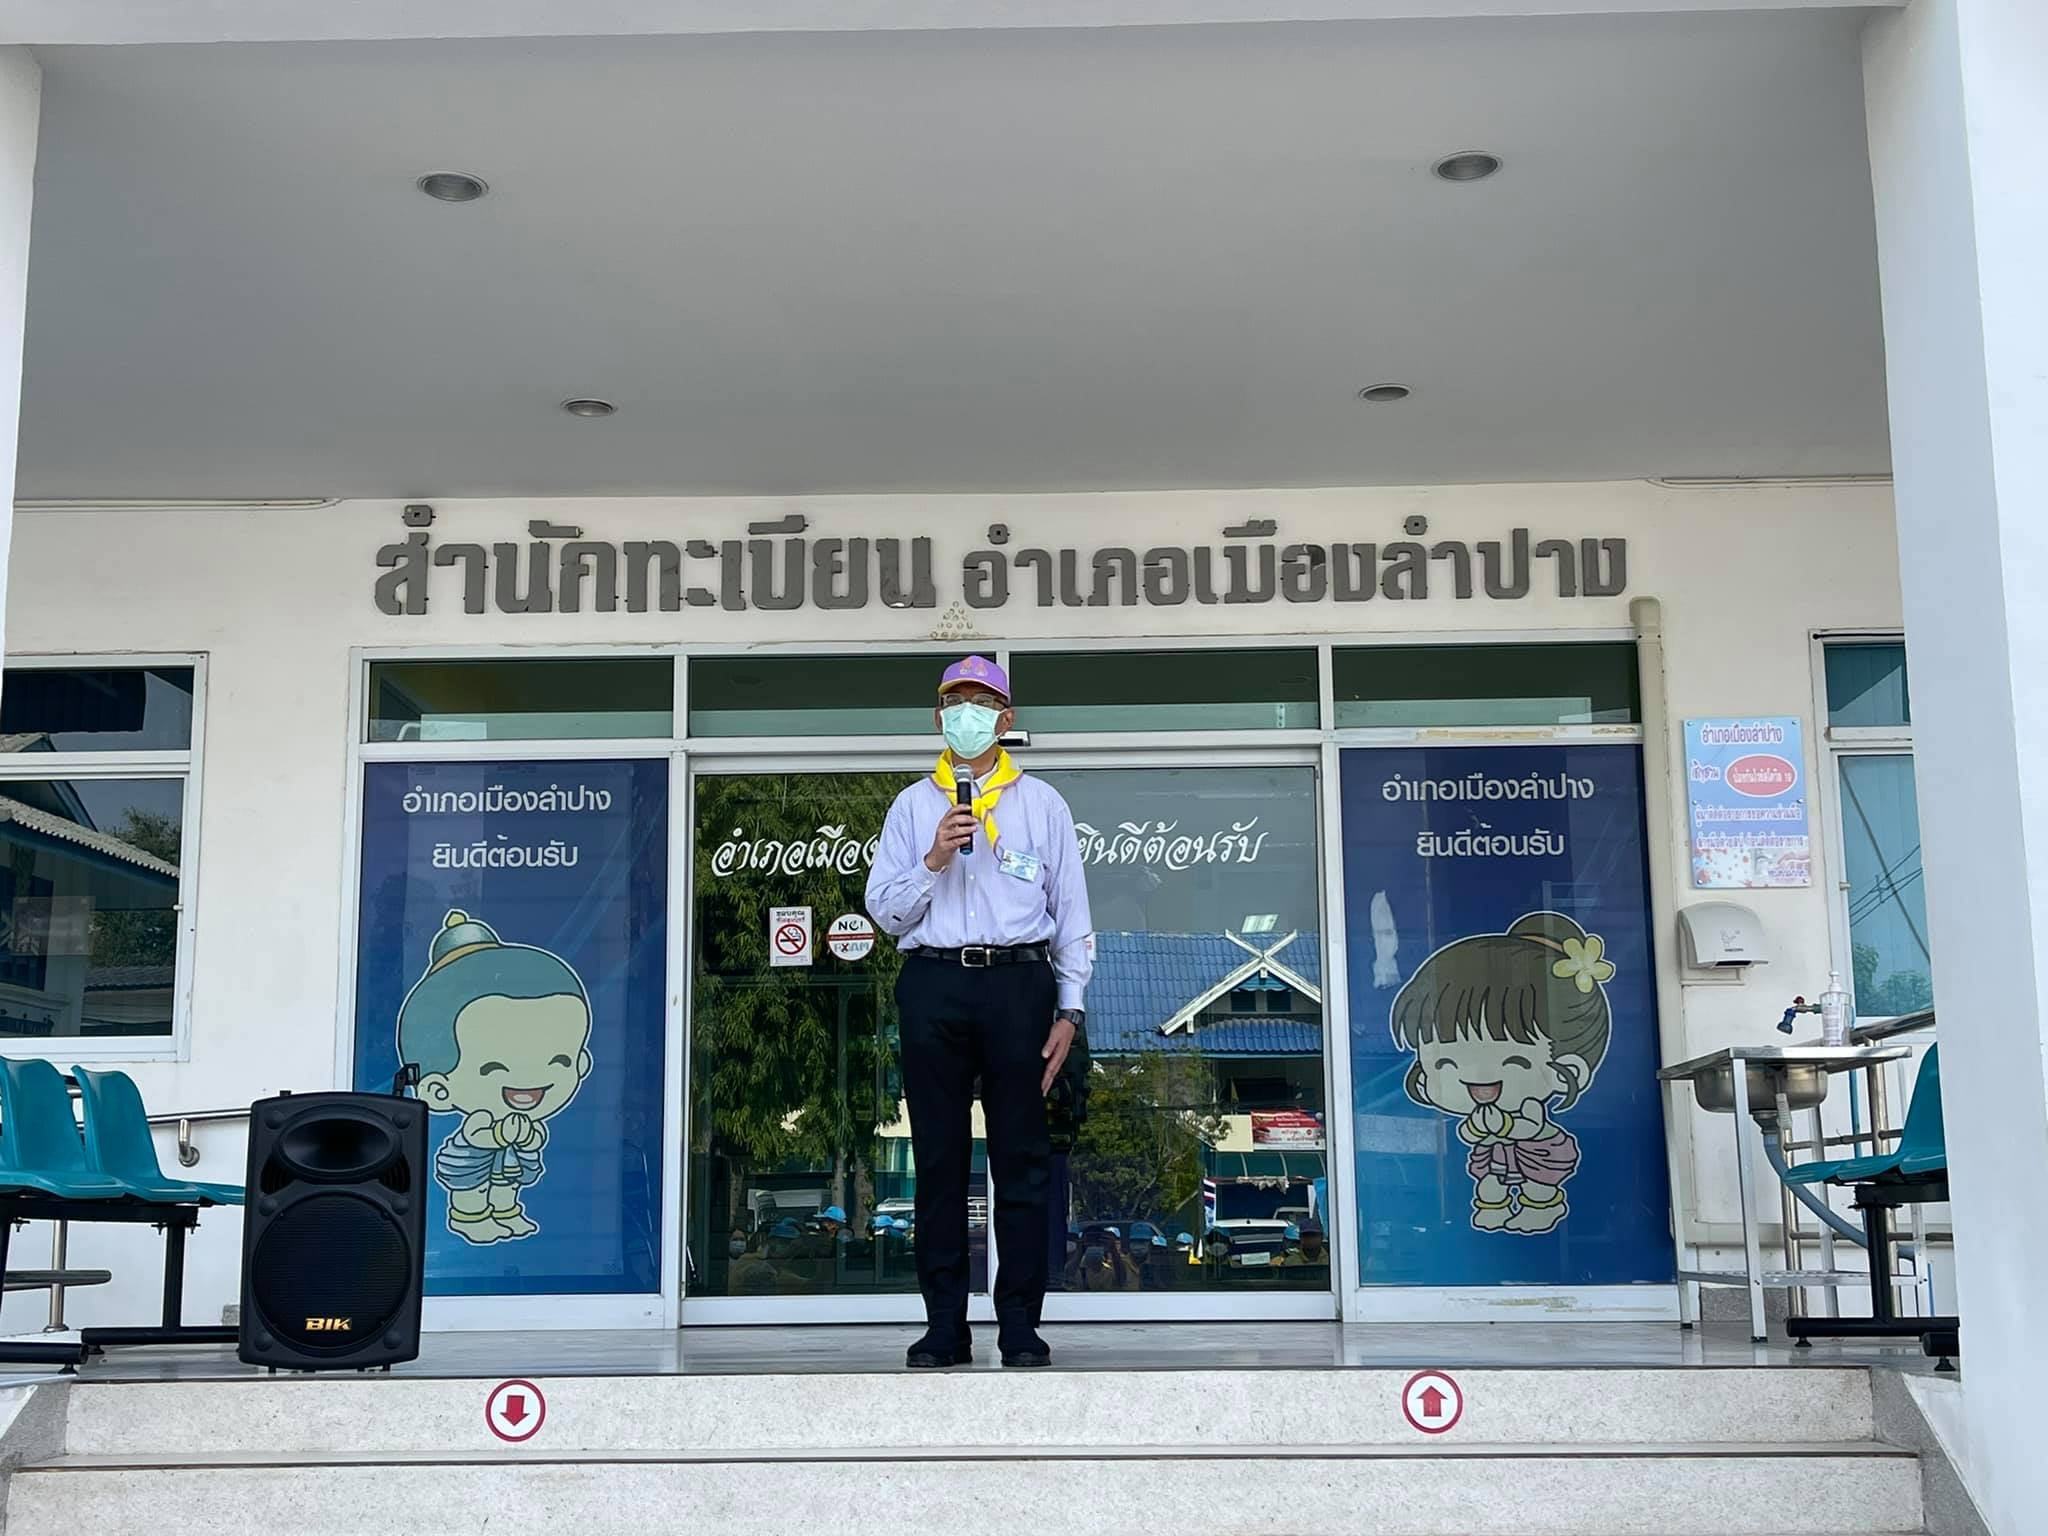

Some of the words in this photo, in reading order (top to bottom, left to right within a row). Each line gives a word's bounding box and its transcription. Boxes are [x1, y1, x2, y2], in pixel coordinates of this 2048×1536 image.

[374, 504, 938, 616] สำนักทะเบียน
[962, 515, 1628, 609] อำเภอเมืองลำปาง
[402, 782, 612, 814] อำเภอเมืองลำปาง
[1381, 772, 1595, 802] อำเภอเมืองลำปาง
[432, 834, 579, 869] ยินดีต้อนรับ
[1416, 823, 1565, 857] ยินดีต้อนรับ
[305, 1318, 352, 1331] BIK
